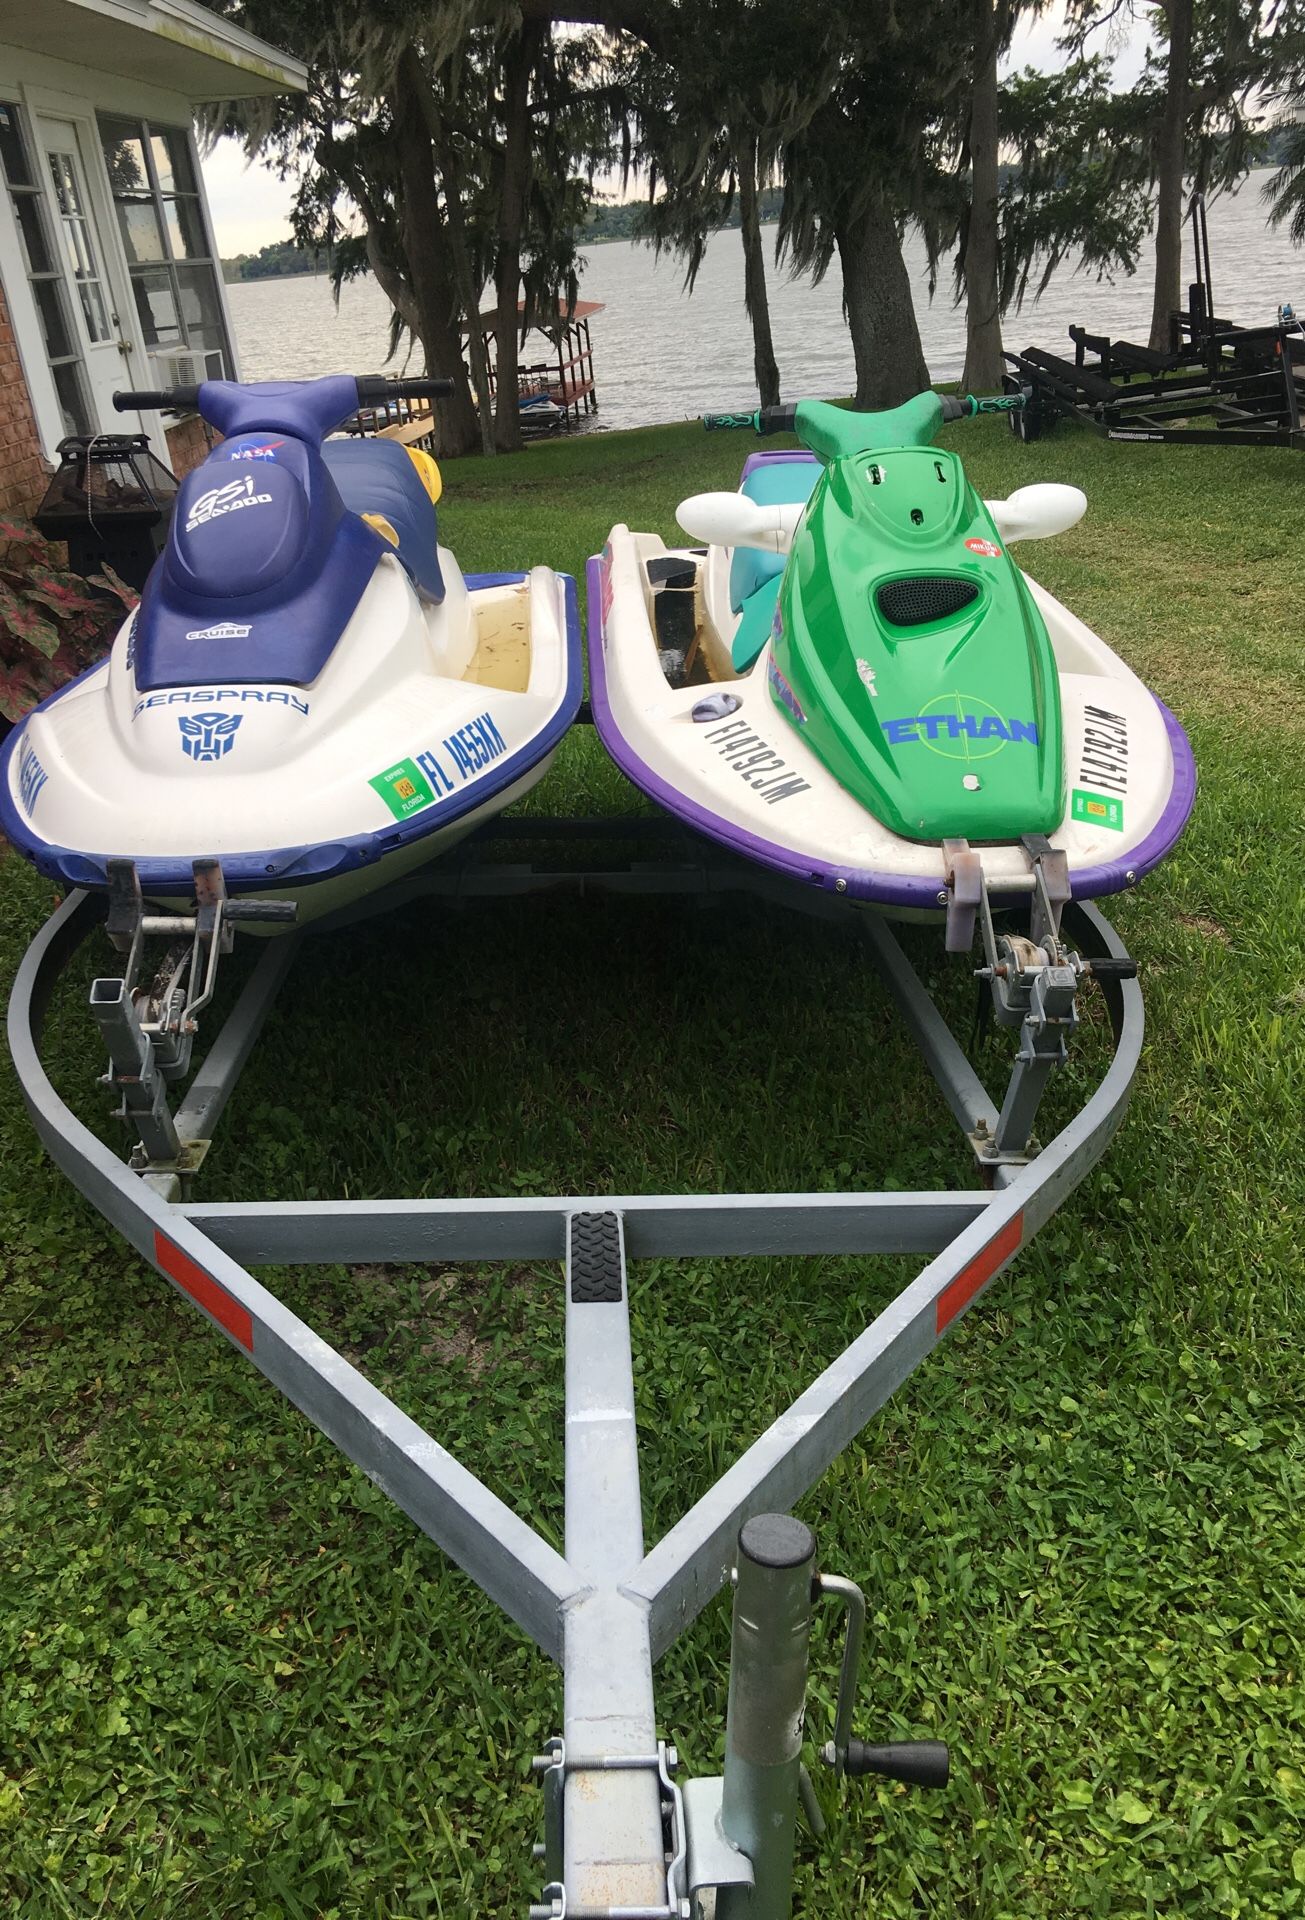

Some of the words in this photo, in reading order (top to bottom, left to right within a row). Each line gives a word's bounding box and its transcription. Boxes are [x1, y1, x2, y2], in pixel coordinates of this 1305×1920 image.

[231, 449, 275, 460] NASA
[131, 690, 309, 722] SEASPRAY
[881, 715, 1039, 747] ETHAN
[416, 751, 455, 797] FL
[442, 712, 507, 780] 1455XX
[1079, 705, 1128, 793] FL4792JM
[402, 793, 426, 812] FLORIDA
